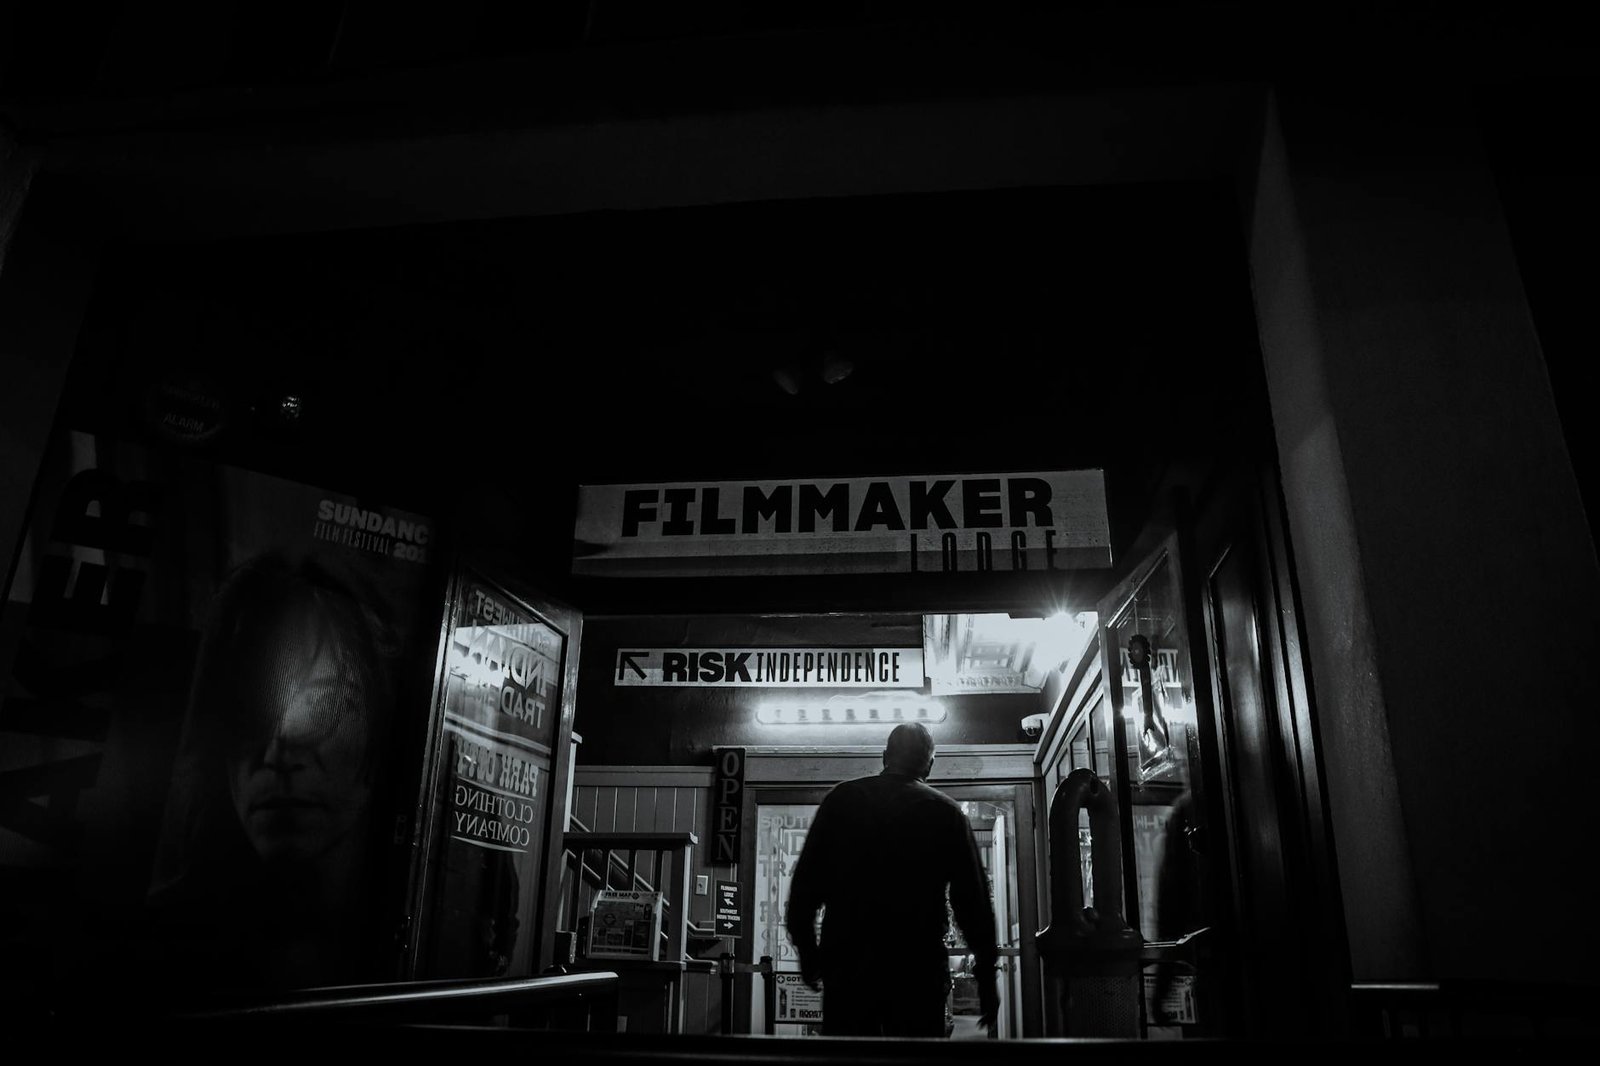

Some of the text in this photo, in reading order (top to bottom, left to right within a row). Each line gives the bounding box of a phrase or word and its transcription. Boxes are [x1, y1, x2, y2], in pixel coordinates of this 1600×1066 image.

[621, 477, 1055, 537] FILMMAKER
[342, 527, 390, 555] FESTIVAL
[663, 651, 900, 683] RISK INDEPENDENCE
[716, 750, 741, 863] OPEN
